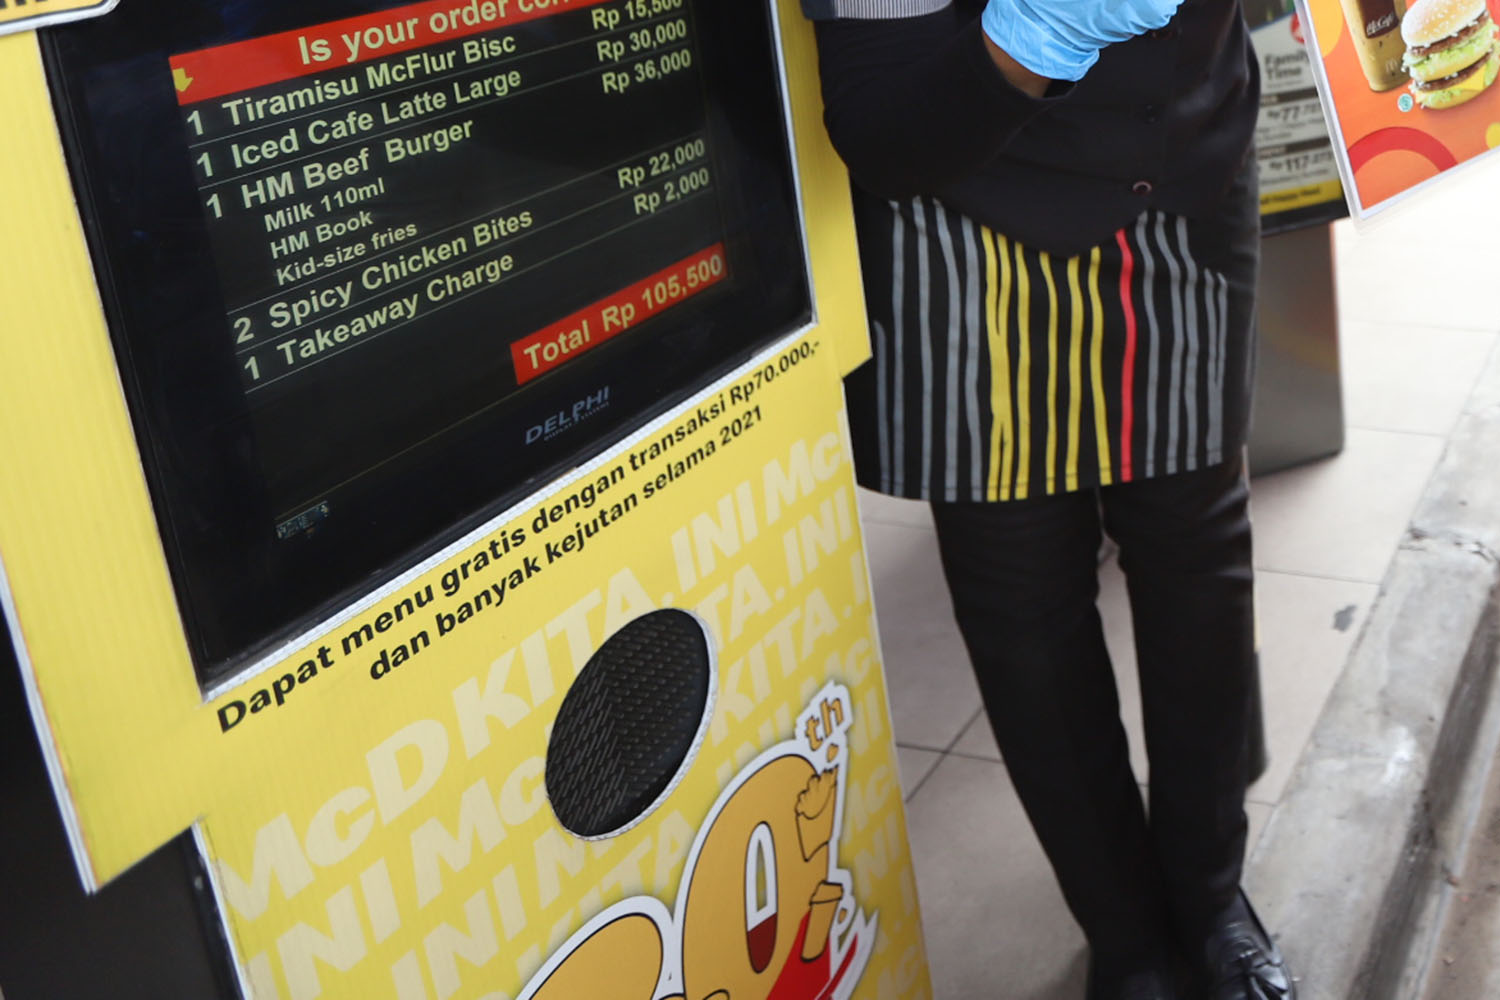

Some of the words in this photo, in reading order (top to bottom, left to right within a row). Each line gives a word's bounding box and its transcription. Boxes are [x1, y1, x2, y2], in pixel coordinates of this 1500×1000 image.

[186, 109, 204, 136] 1
[221, 76, 359, 127] Tiramisu
[365, 49, 457, 90] McFlur
[462, 35, 516, 64] Bisc
[591, 6, 621, 31] Rp
[196, 151, 213, 178] 1
[230, 128, 301, 170] Iced
[306, 111, 375, 146] Cafe
[380, 88, 448, 126] Latte
[452, 69, 521, 105] Large
[596, 38, 625, 63] Rp
[628, 18, 688, 54] 30,000
[297, 34, 333, 66] Is
[340, 17, 419, 63] your
[205, 192, 224, 219] 1
[240, 170, 296, 210] HM
[302, 147, 370, 190] Beef
[384, 118, 474, 164] Burger
[601, 70, 631, 94] Rp
[633, 48, 692, 84] 36,000
[233, 316, 255, 345] 2
[268, 281, 354, 330] Spicy
[361, 235, 469, 291] Chicken
[472, 208, 535, 249] Bites
[616, 165, 646, 189] Rp
[648, 138, 706, 178] 22,000
[263, 201, 315, 233] Milk
[320, 177, 386, 214] 110ml
[269, 234, 311, 261] HM
[315, 209, 376, 244] Book
[275, 239, 368, 287] Kid-size
[370, 221, 419, 252] fries
[243, 355, 262, 382] 1
[275, 294, 420, 367] Takeaway
[425, 253, 515, 304] Charge
[632, 190, 661, 215] Rp
[663, 167, 710, 205] 2,000
[522, 319, 591, 370] Total
[600, 300, 636, 332] Rp
[640, 253, 724, 311] 105,500
[525, 385, 610, 445] DELPHI
[215, 644, 336, 735] Dapat
[340, 583, 436, 657] menu
[439, 526, 527, 599] gratis
[531, 464, 626, 533] dengan
[628, 393, 727, 472] transaksi
[729, 337, 822, 409] Rp70.000,-
[368, 628, 432, 681] dan
[434, 556, 542, 638] banyak
[544, 492, 640, 566] kejutan
[641, 439, 718, 500] selama
[719, 404, 764, 447] 2021
[805, 697, 844, 752] th
